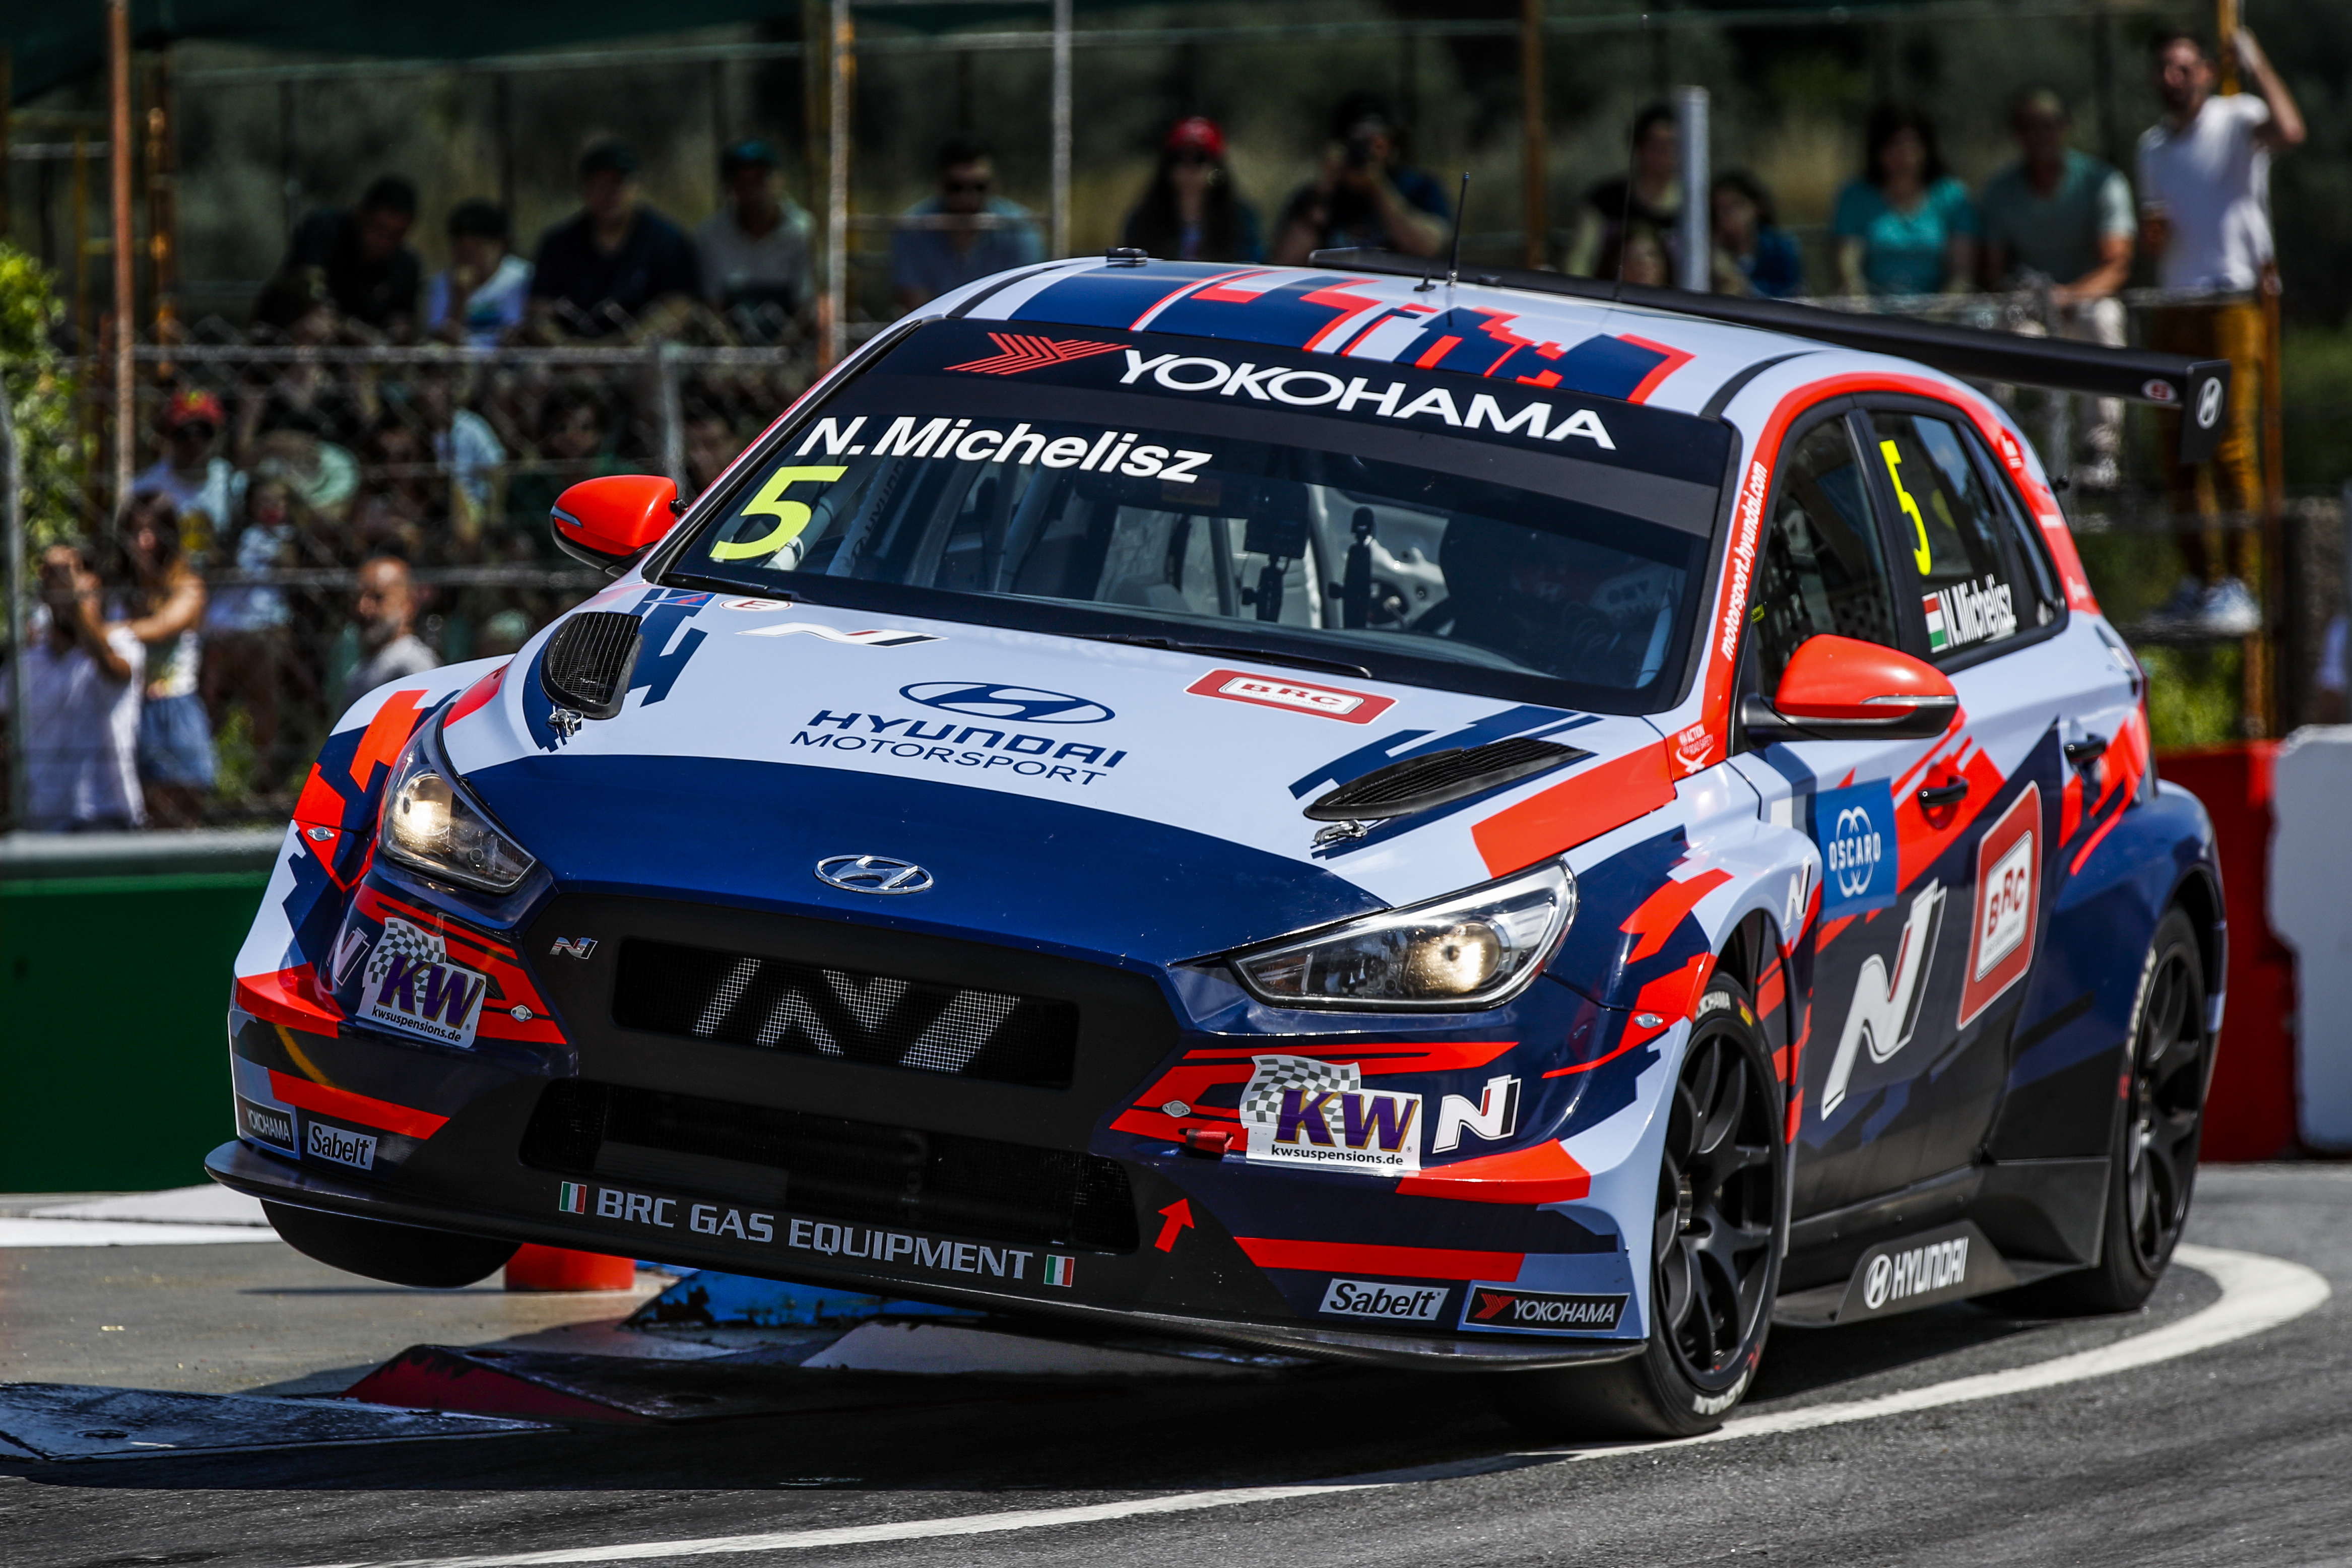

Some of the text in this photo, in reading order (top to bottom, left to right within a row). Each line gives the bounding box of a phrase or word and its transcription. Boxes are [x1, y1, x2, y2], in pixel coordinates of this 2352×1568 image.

[1119, 349, 1616, 450] YOKOHAMA
[795, 416, 1213, 484] N.Michelisz
[709, 465, 848, 560] 5
[1879, 439, 1932, 576] 5
[1720, 460, 1768, 662] motorsport.hyundai.com
[740, 599, 778, 610] E
[1938, 573, 2017, 648] N.Michelisz
[1240, 683, 1342, 705] BRC
[789, 731, 1108, 786] MOTORSPORT
[806, 709, 1129, 769] HYUNDAI
[1828, 831, 1881, 872] OSCARO
[1987, 864, 2027, 939] BRC
[376, 953, 485, 1030] KW
[1695, 991, 1731, 1022] OKOHAMA
[371, 1005, 462, 1042] kwsuspensions.de
[245, 1105, 291, 1143] YOKOHAMA
[310, 1125, 369, 1166] Sabelt
[1273, 1087, 1420, 1154] KW
[1271, 1143, 1404, 1166] kwsuspensions.de
[596, 1187, 1034, 1280] BRC GAS EQUIPMENT
[1890, 1235, 1970, 1301] HYUNDAI
[1329, 1282, 1436, 1318] Sabelt
[1514, 1299, 1616, 1324] YOKOHAMA
